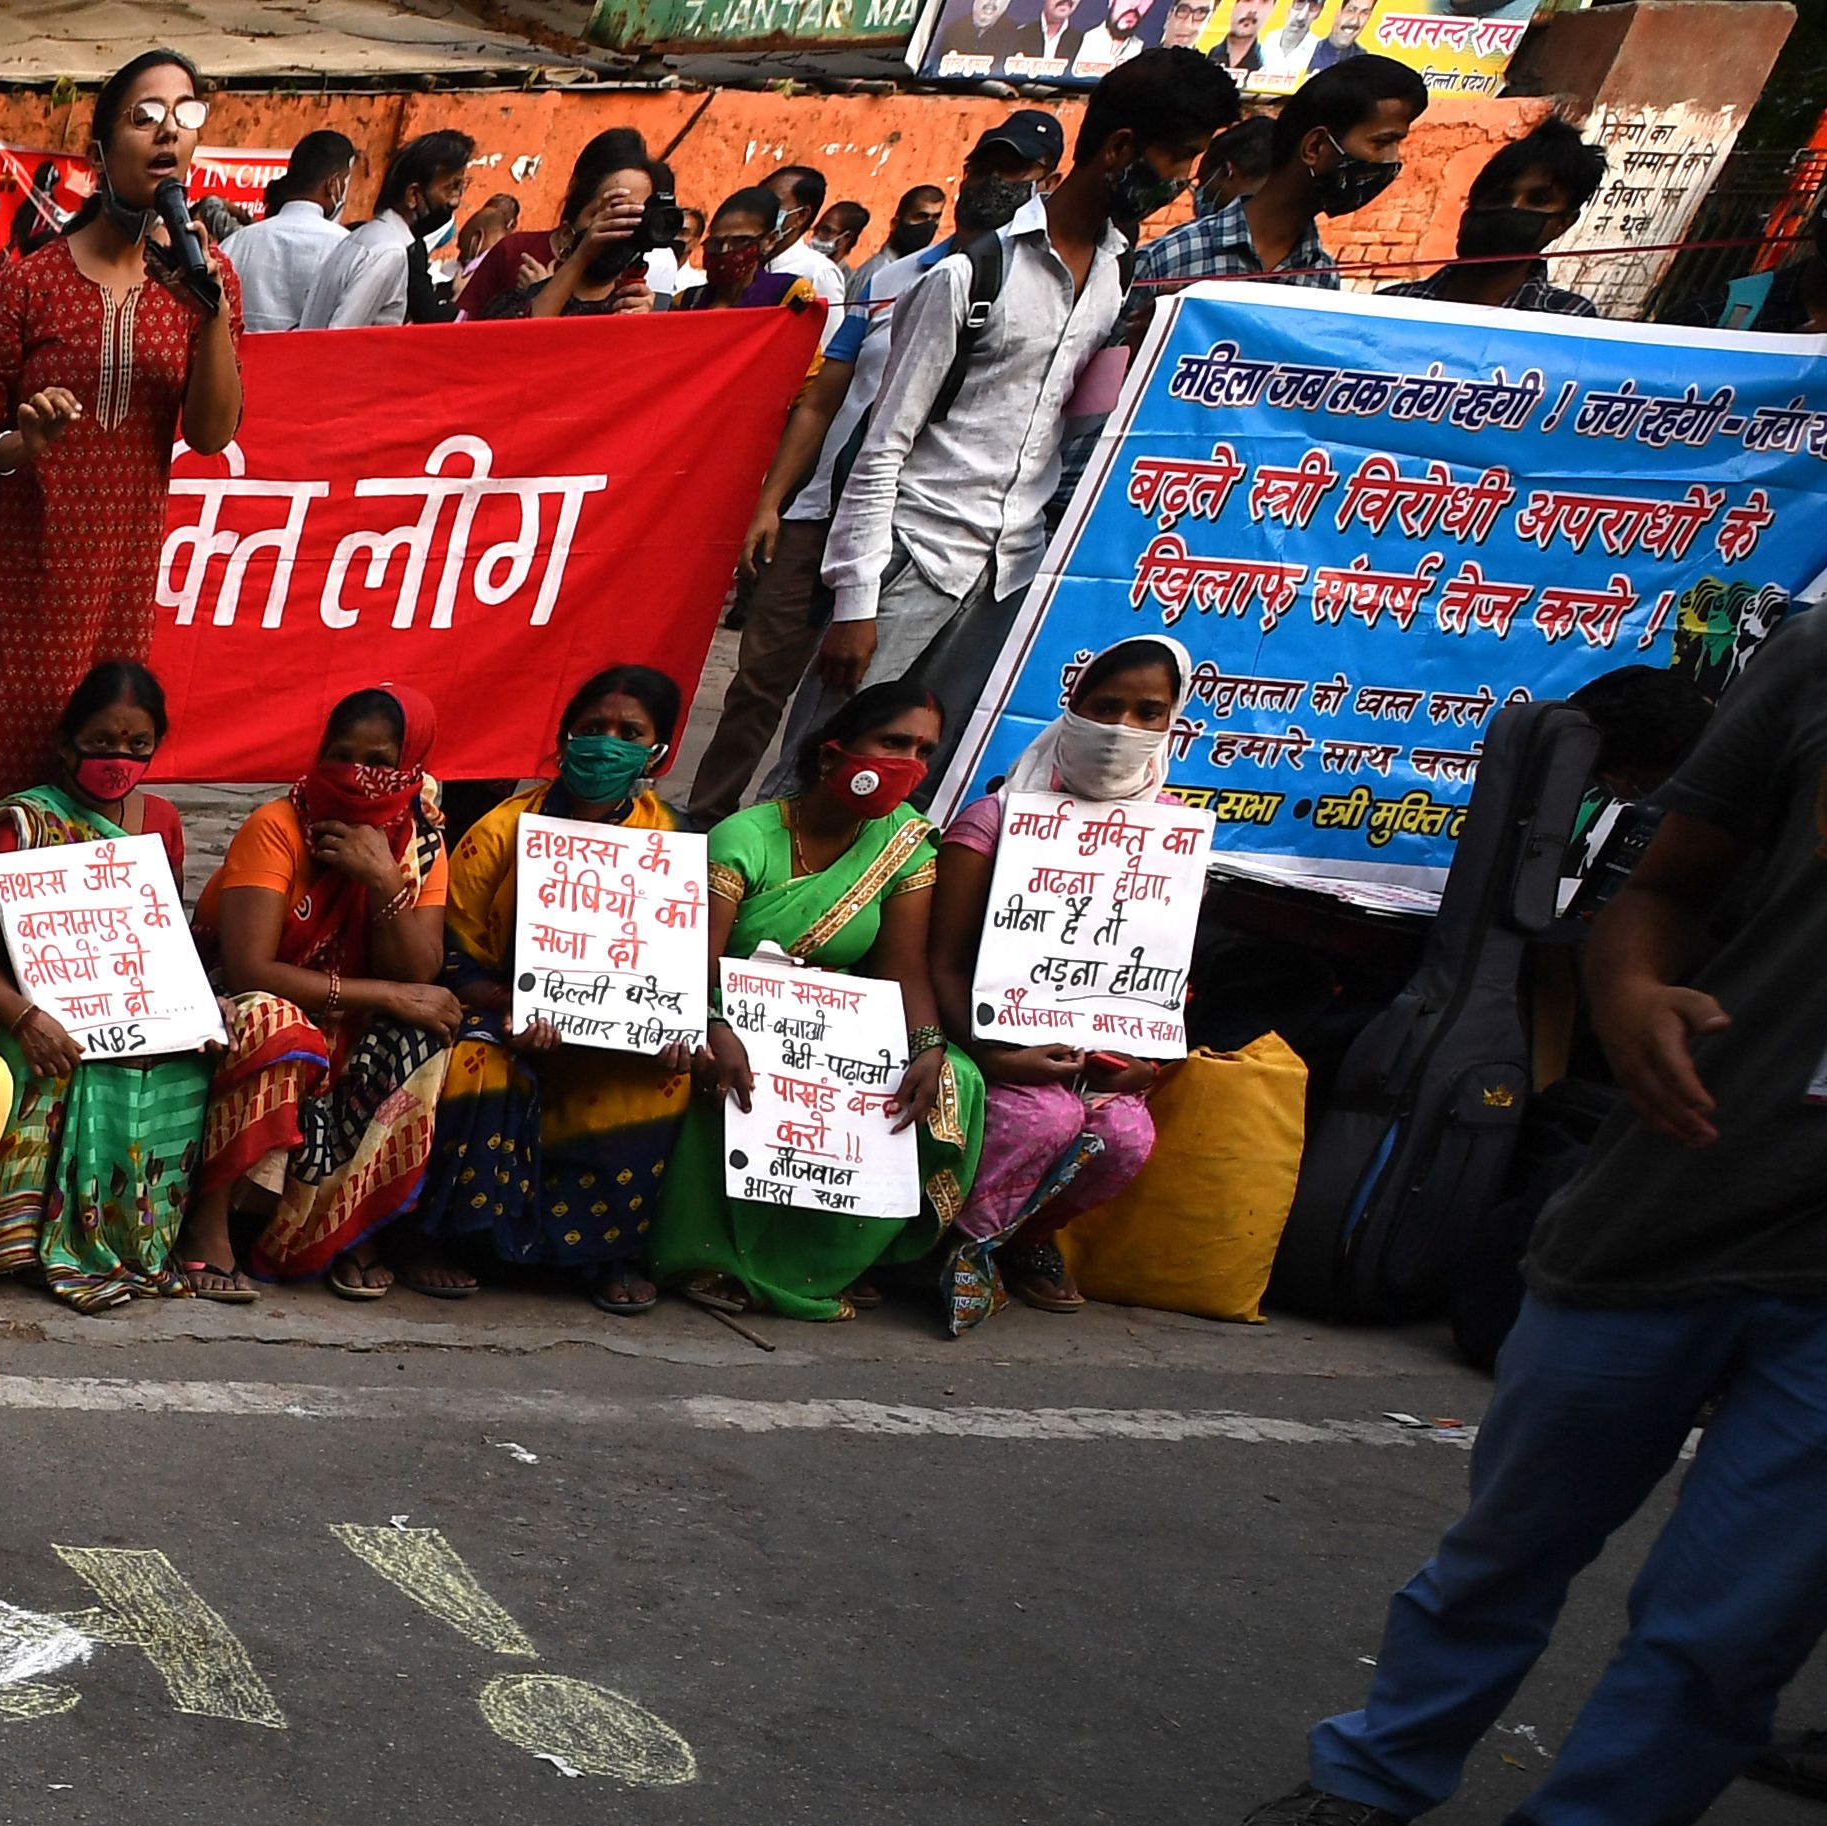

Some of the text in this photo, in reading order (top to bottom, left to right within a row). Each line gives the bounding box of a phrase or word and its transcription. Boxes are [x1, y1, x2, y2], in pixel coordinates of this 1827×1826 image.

[1376, 13, 1528, 57] दयानन्द राय
[1651, 125, 1677, 143] का
[202, 165, 228, 188] IN
[1166, 340, 1647, 439] महिला जब तक तंग रहेगी जंग
[1126, 439, 1775, 565] बढ़ते स्त्री विरोधी अपराधों के
[319, 435, 607, 634] लीग
[1314, 549, 1635, 647] संघर्ष तेज करो
[1311, 671, 1494, 730] को ध्वस्त करने
[1209, 725, 1402, 779] हमारे साथ
[1009, 800, 1204, 857] मार्ग मुक्ति का
[1216, 783, 1446, 847] सभा स्त्री मुक्ति
[84, 842, 137, 890] और
[526, 829, 671, 876] हाथरस के
[538, 860, 706, 929] दोषियों को
[1028, 867, 1105, 898] गढ़ना
[17, 883, 171, 943] बलरामपुर के
[994, 893, 1128, 946] जीना है तो
[23, 932, 151, 988] दोषियों को
[529, 921, 648, 970] सजा दो
[539, 970, 616, 1005] दिल्ली
[726, 971, 867, 1015] भाजपा सरकार
[1030, 956, 1108, 992] लड़ना
[55, 993, 112, 1019] सजा
[998, 988, 1184, 1044] नौजवान भारत सभा
[87, 1024, 146, 1053] NBS
[776, 1112, 831, 1151] करो
[769, 1147, 859, 1186] नौजवान
[744, 1176, 861, 1210] भारत सभा
